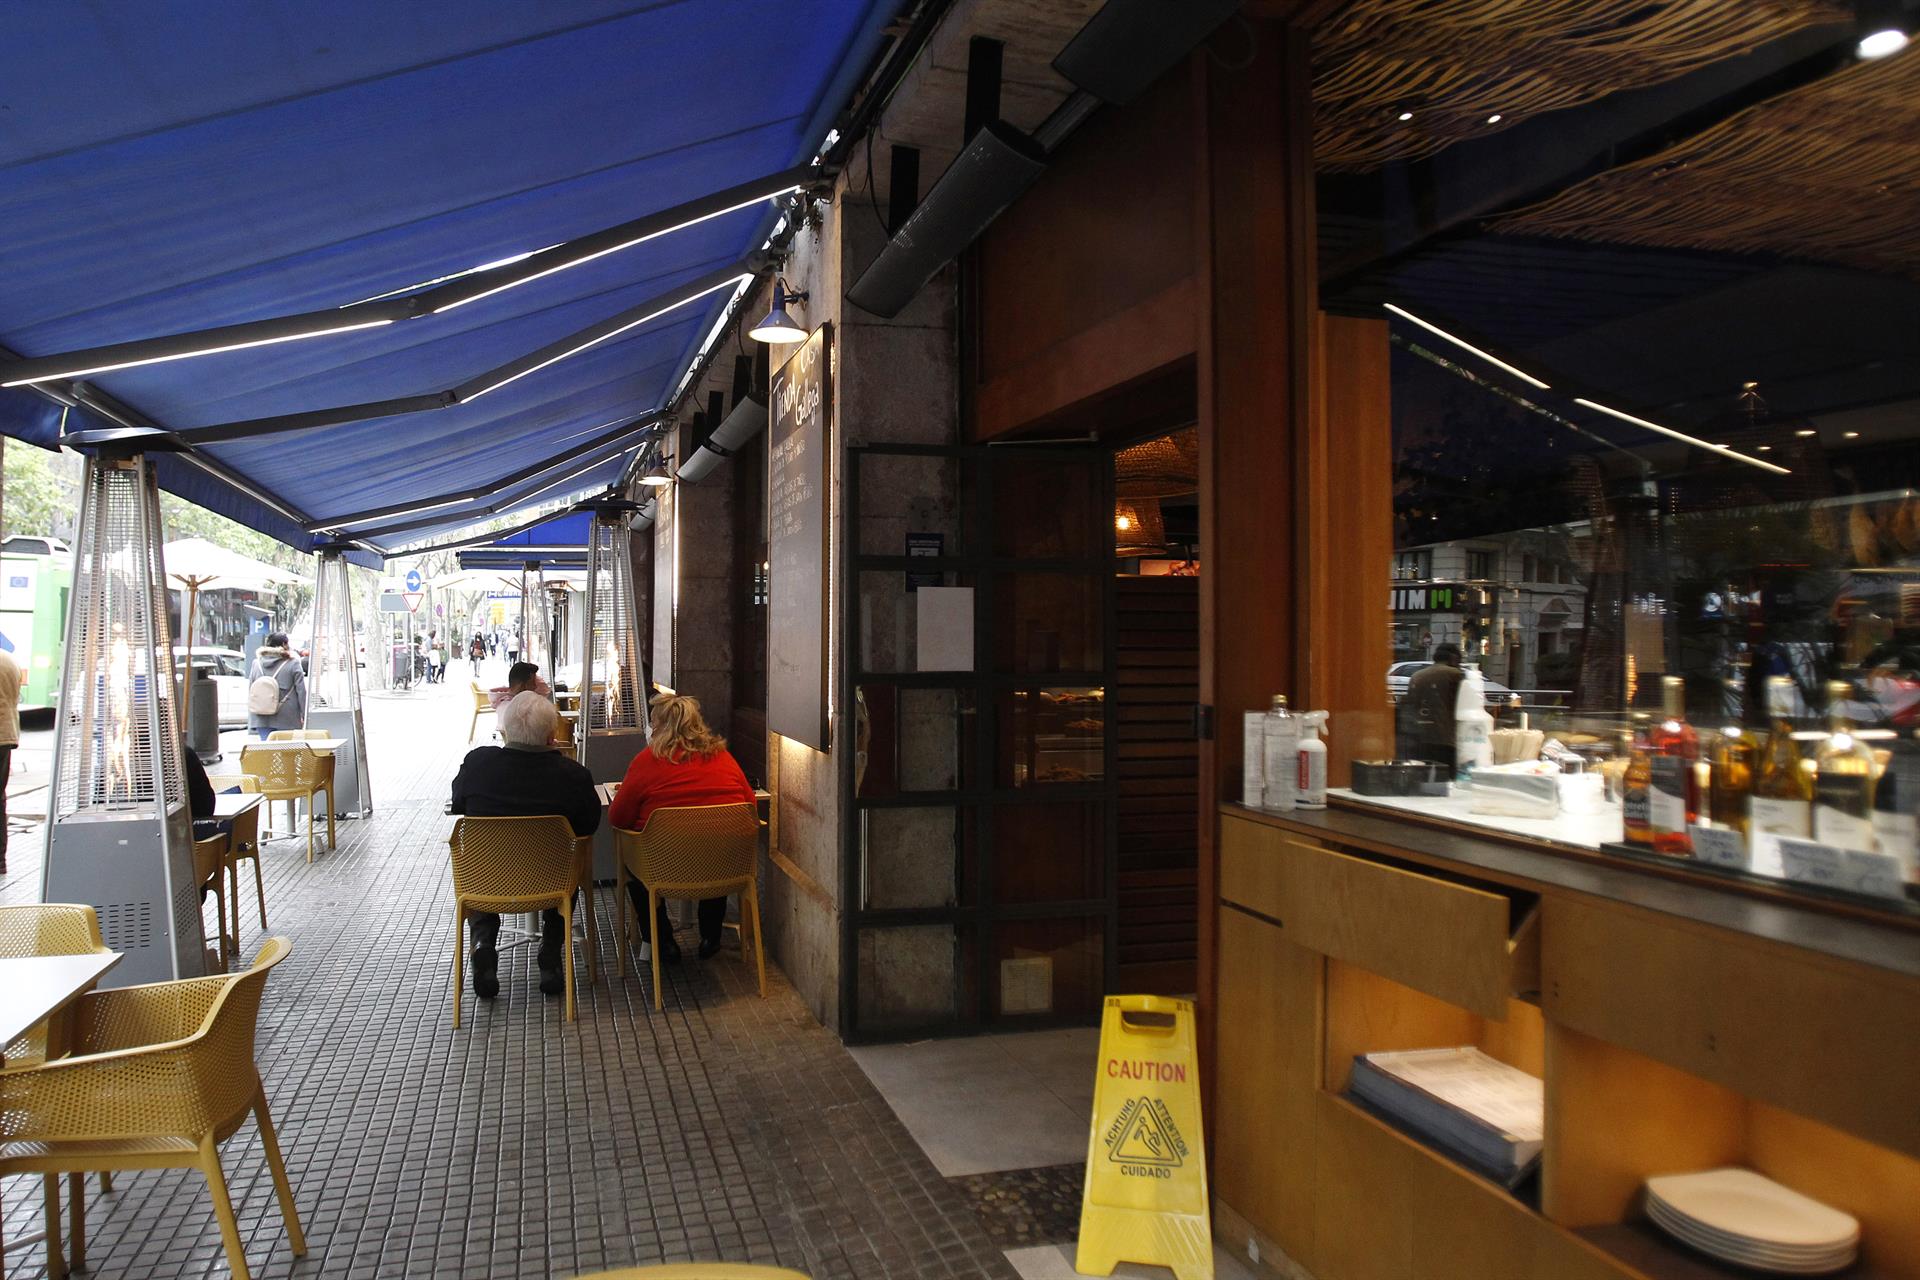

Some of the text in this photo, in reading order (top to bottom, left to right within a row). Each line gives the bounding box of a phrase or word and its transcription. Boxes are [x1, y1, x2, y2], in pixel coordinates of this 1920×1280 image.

[255, 620, 264, 633] P
[1107, 1059, 1186, 1082] CAUTION
[1104, 1098, 1136, 1148] ACHTUNG
[1154, 1098, 1190, 1157] ATTENTION
[1121, 1165, 1171, 1179] CUIDADO
